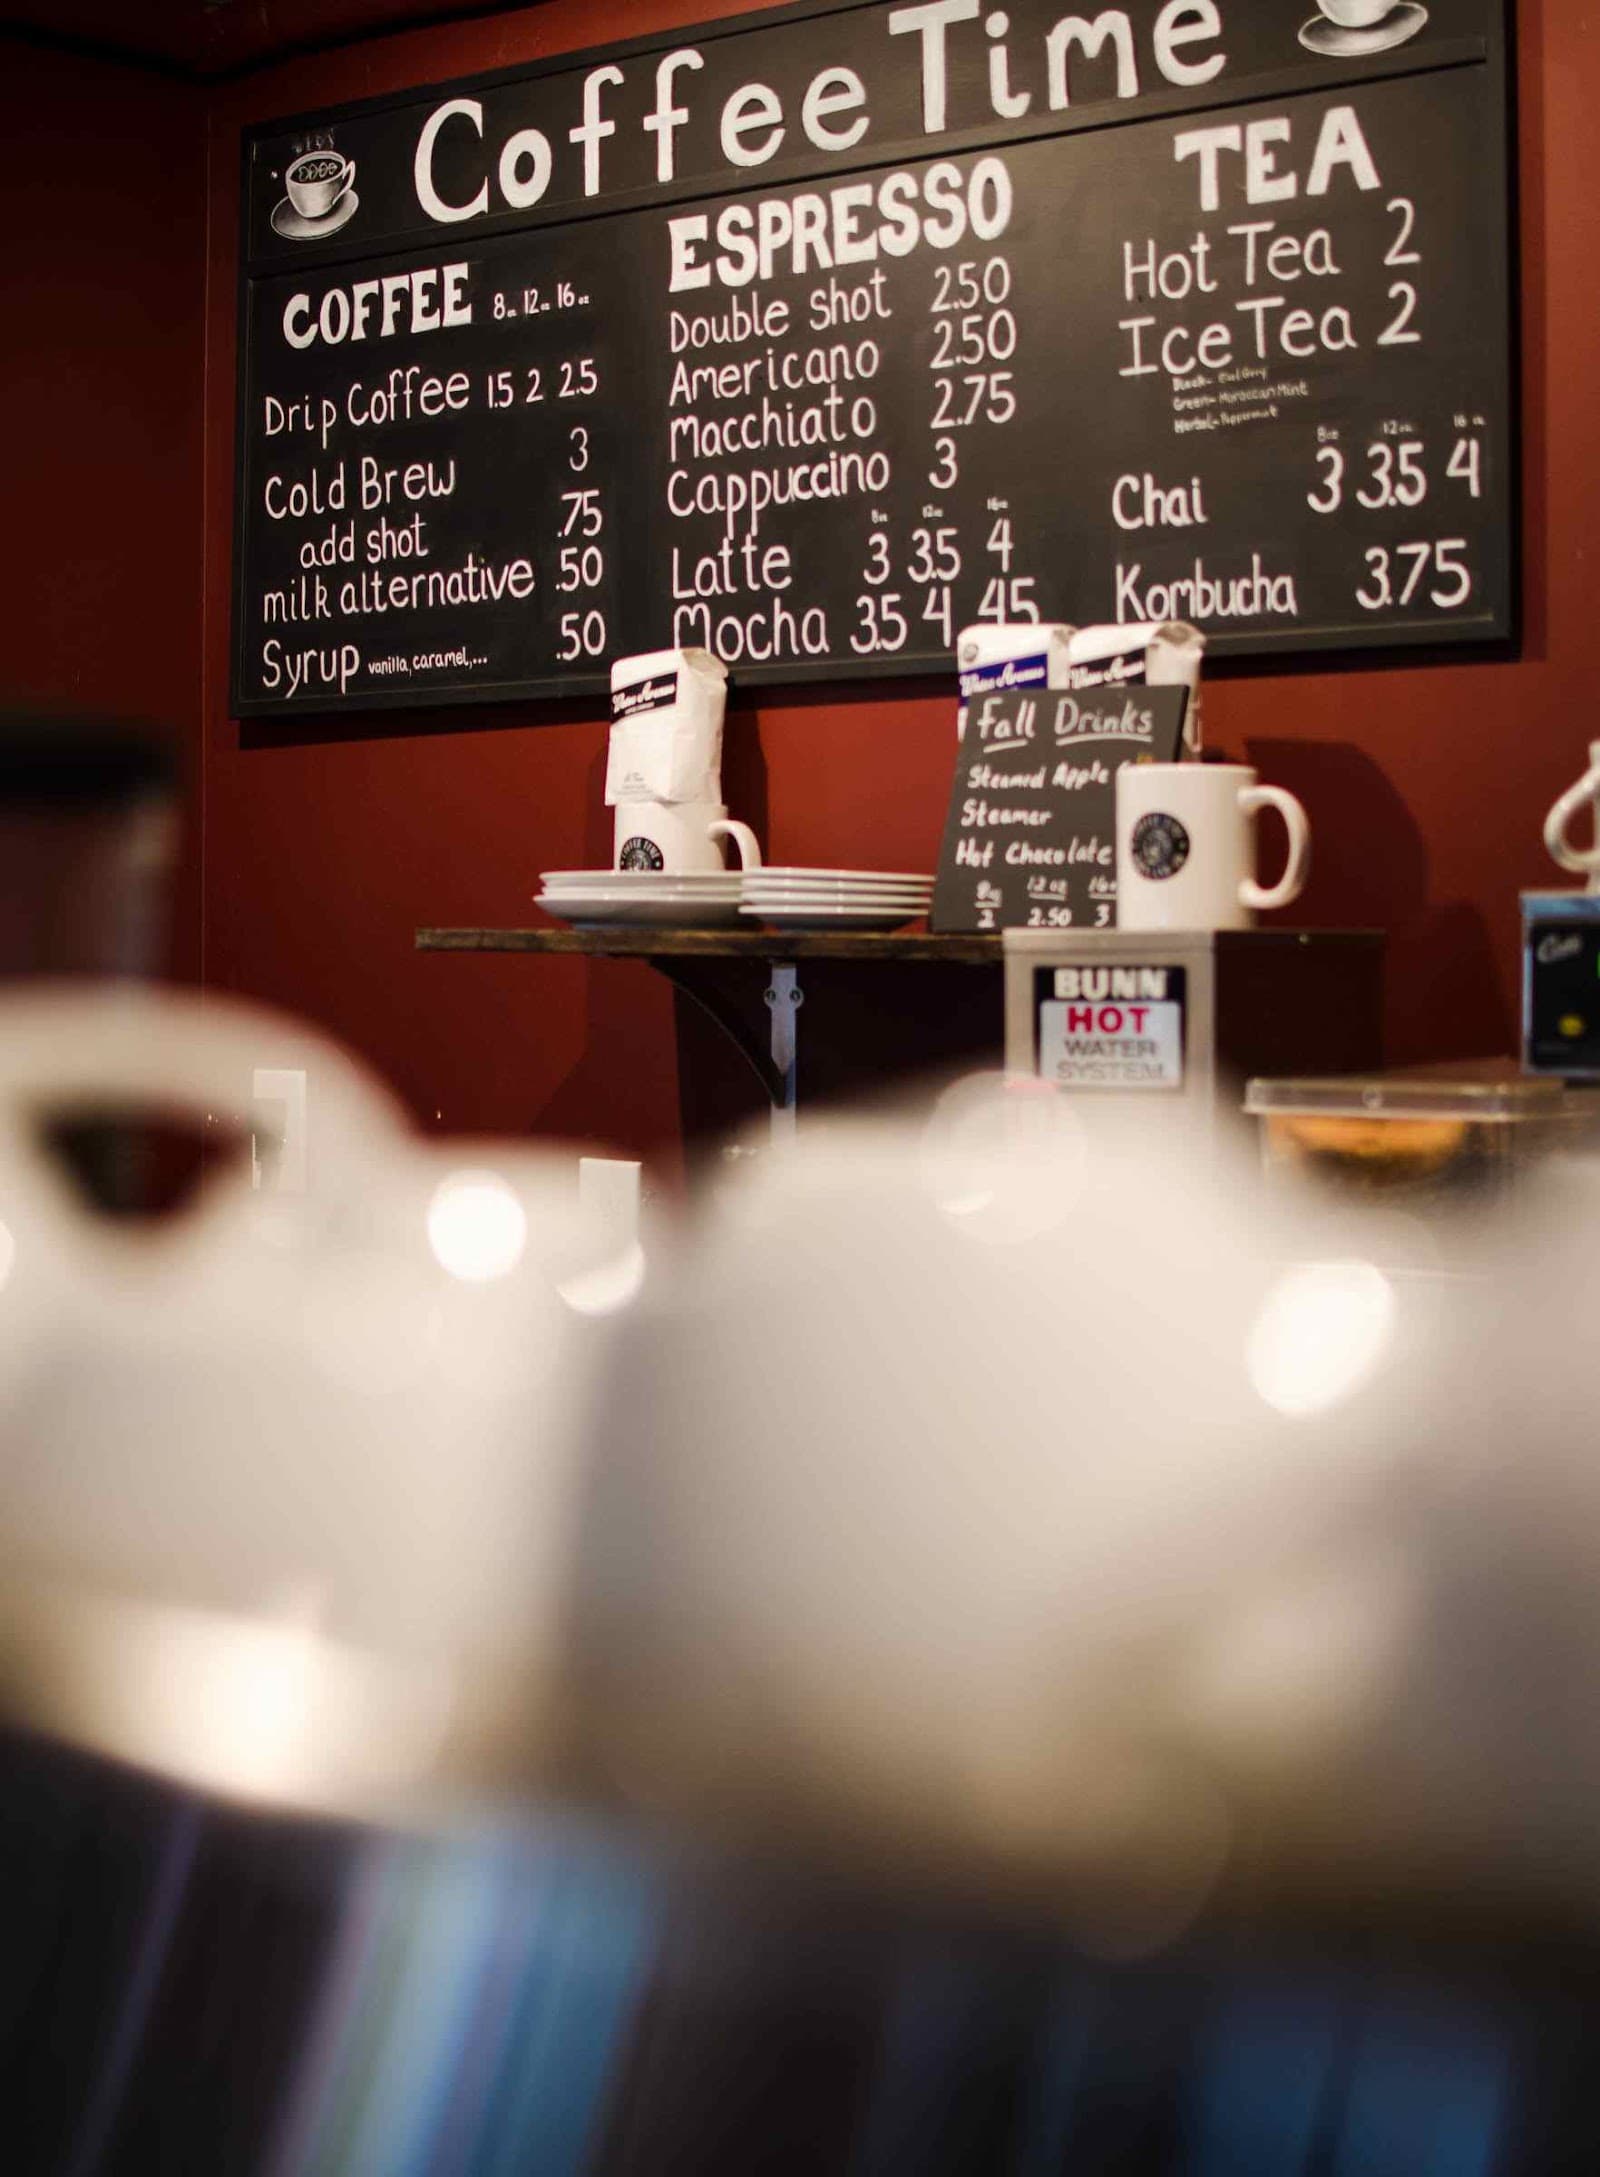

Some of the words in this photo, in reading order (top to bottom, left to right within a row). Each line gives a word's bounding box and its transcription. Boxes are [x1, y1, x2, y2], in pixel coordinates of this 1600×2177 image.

[414, 48, 872, 223] Coffee
[888, 0, 1228, 134] Time
[1174, 106, 1381, 212] TEA
[668, 157, 1013, 293] ESPRESSO
[1123, 231, 1218, 301] Hot
[1227, 221, 1342, 286] Tea
[1384, 198, 1422, 265] 2
[282, 262, 472, 350] COFFEE
[670, 291, 790, 353] Double
[809, 267, 893, 331] shot
[930, 256, 1011, 313] 2.50
[1118, 316, 1233, 377] Ice
[1235, 296, 1358, 359] Tea
[1377, 282, 1422, 345] 2
[668, 340, 880, 407] Americano
[929, 308, 1017, 369] 2.50
[264, 394, 337, 449] Drip
[347, 366, 470, 426] Coffee
[488, 371, 514, 409] 1.5
[526, 368, 544, 403] 2
[558, 359, 598, 398] 2.5
[670, 384, 877, 463] Macchiato
[930, 372, 1016, 429] 2.75
[264, 459, 346, 519] Cold
[361, 456, 455, 510] Brew
[569, 427, 589, 472] 3
[667, 451, 890, 541] Cappuccino
[929, 437, 958, 489] 3
[1112, 473, 1208, 530] Chai
[1307, 446, 1344, 514] 3
[1355, 442, 1428, 510] 3.5
[1445, 437, 1481, 498] 4
[300, 519, 355, 570] add
[366, 512, 429, 564] shot
[557, 489, 603, 537] .75
[672, 533, 793, 600] Latte
[863, 532, 890, 585] 3
[907, 528, 961, 584] 3.5
[986, 517, 1014, 573] 4
[263, 572, 333, 624] milk
[339, 552, 536, 616] alternative
[555, 545, 604, 592] .50
[673, 597, 831, 662] Mocha
[850, 593, 908, 654] 3.5
[921, 586, 951, 648] 4
[1115, 552, 1298, 626] Kombucha
[1355, 538, 1471, 609] 3.75
[261, 639, 361, 699] Syrup
[556, 610, 607, 662] .50
[977, 697, 1037, 740] Fall
[1053, 696, 1154, 737] Drinks
[960, 797, 1053, 828] Steamer
[1051, 759, 1110, 791] Apple
[955, 836, 994, 868] Hot
[1004, 835, 1113, 866] Chocolate
[976, 907, 996, 929] 2
[1027, 905, 1073, 927] 2.50
[1094, 904, 1111, 928] 3
[1054, 967, 1168, 1001] BUNN
[1067, 1006, 1151, 1034] HOT
[1064, 1038, 1157, 1058] WATER
